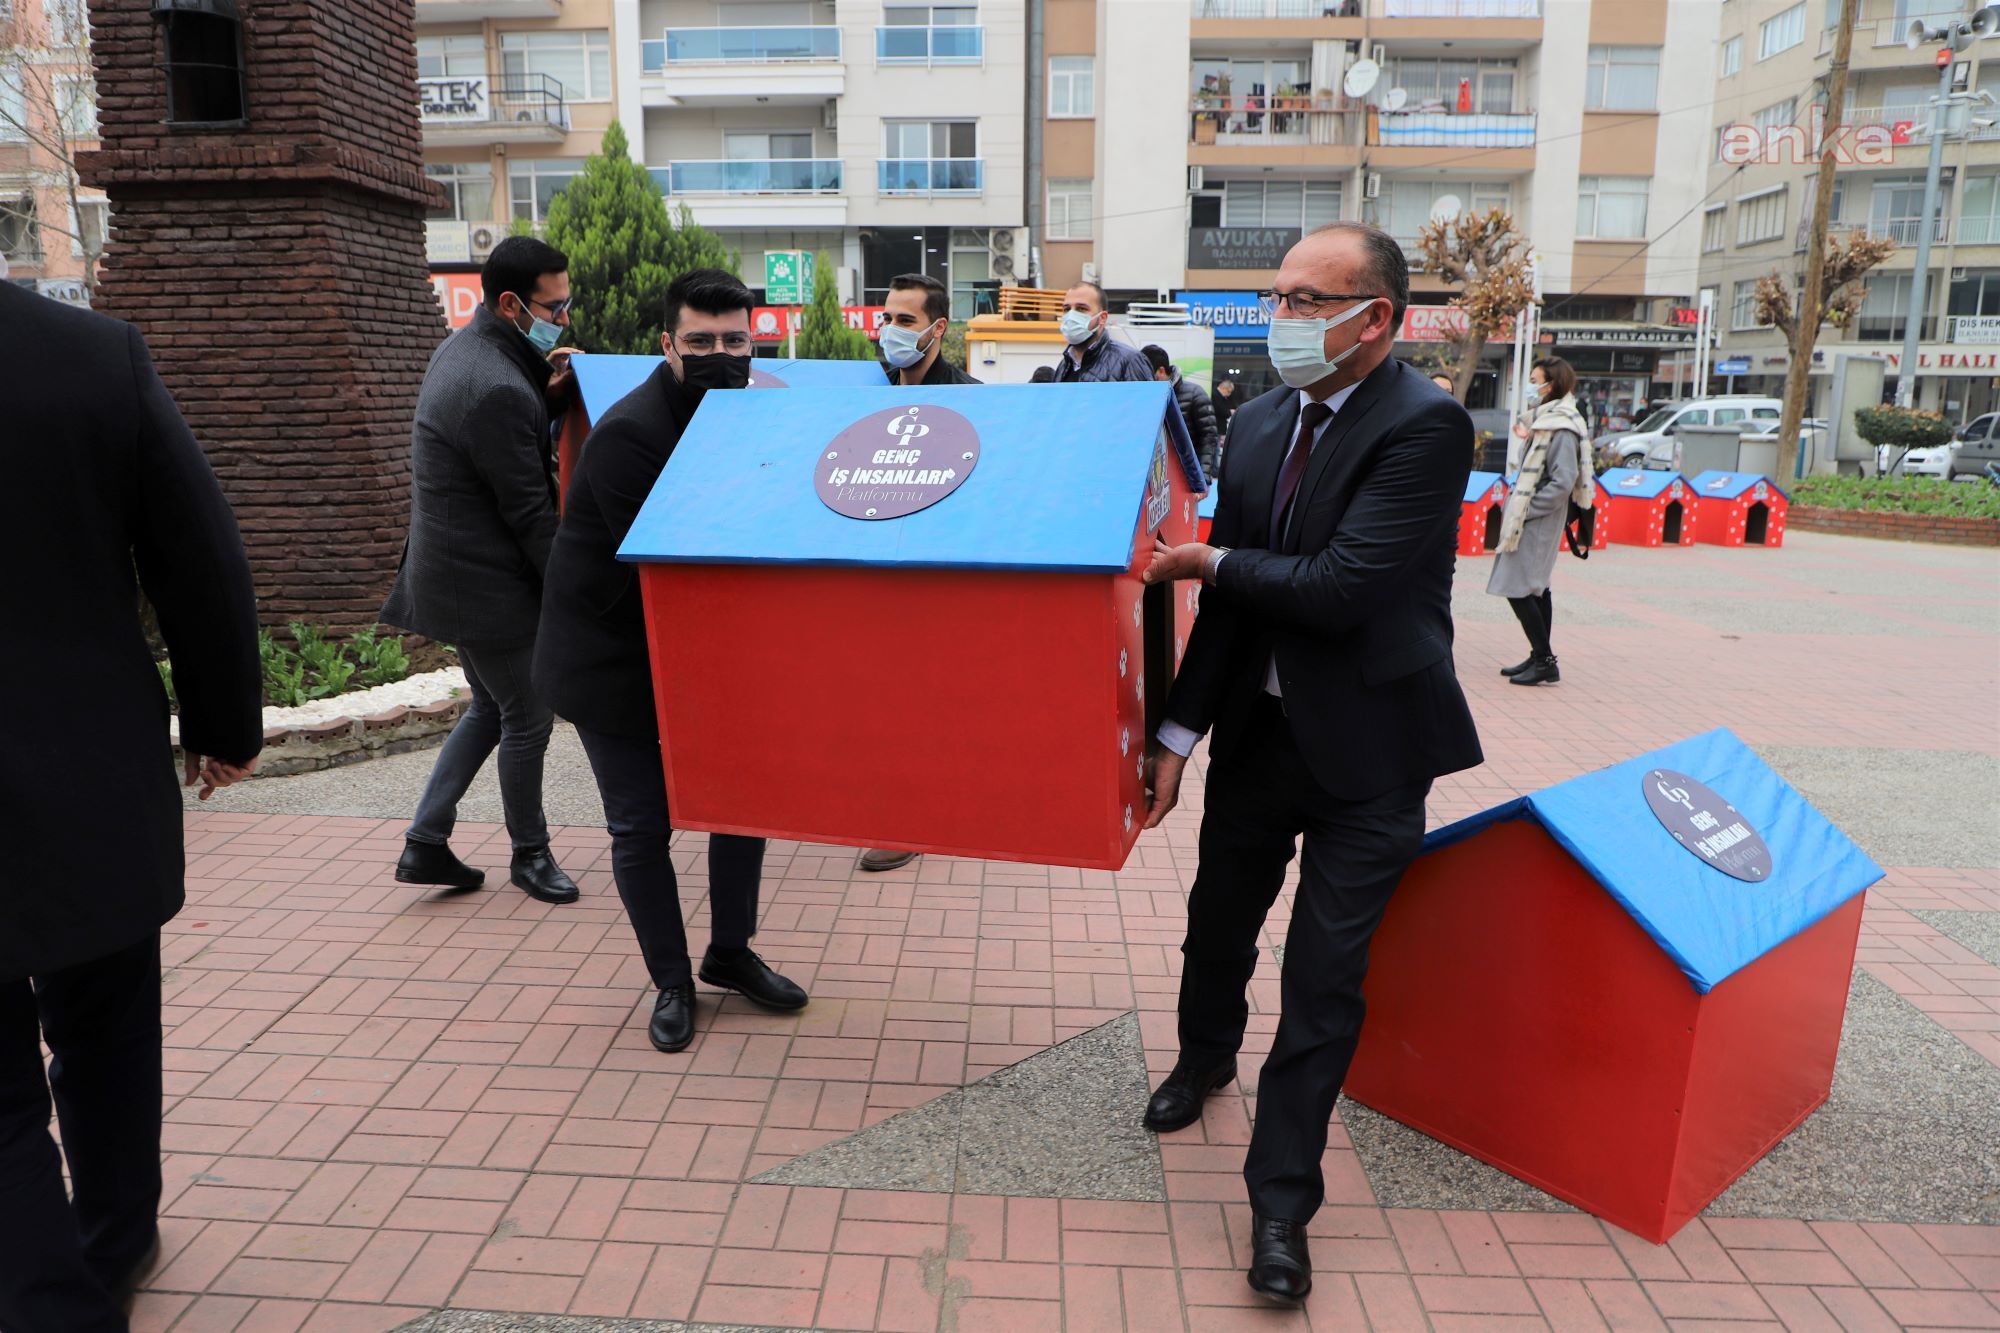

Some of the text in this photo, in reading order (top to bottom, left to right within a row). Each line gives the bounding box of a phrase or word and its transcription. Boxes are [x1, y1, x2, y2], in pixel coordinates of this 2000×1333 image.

[1202, 231, 1288, 246] AVUKAT
[1192, 302, 1269, 325] ÖZGÜVEN
[1939, 354, 1997, 368] HALI
[872, 449, 921, 467] GENÇ
[828, 467, 956, 487] İŞ İNSANLARI
[836, 486, 926, 501] Platformu
[1690, 810, 1720, 832] GENÇ
